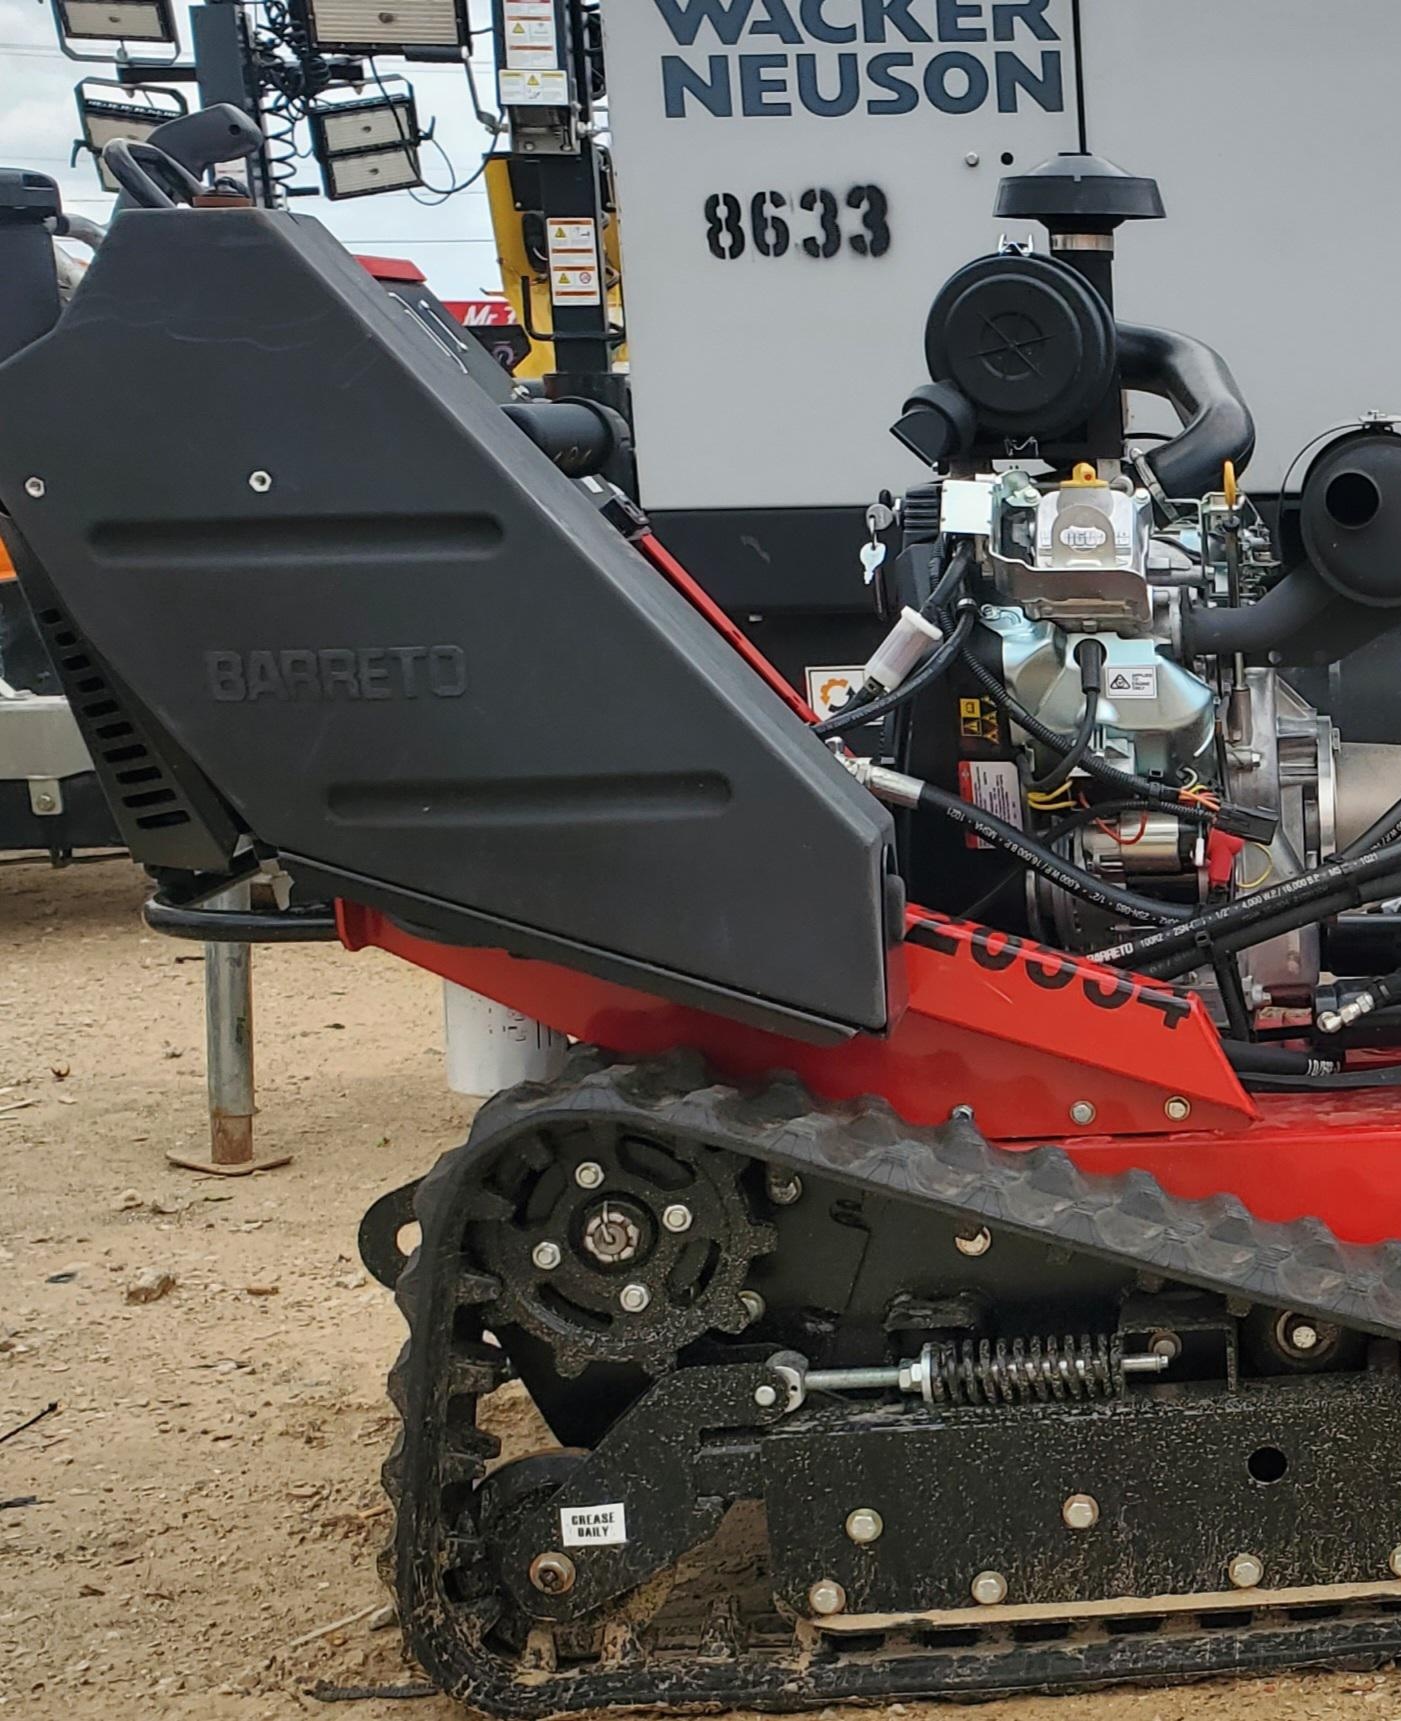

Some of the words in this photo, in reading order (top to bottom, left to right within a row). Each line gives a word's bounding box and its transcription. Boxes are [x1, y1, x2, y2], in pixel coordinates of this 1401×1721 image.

[655, 0, 1061, 46] WACKER
[661, 50, 1064, 118] NEUSON
[704, 184, 891, 260] 8633
[207, 644, 466, 702] BARRETO
[571, 1511, 616, 1526] GREASE
[577, 1525, 609, 1538] DAILY
